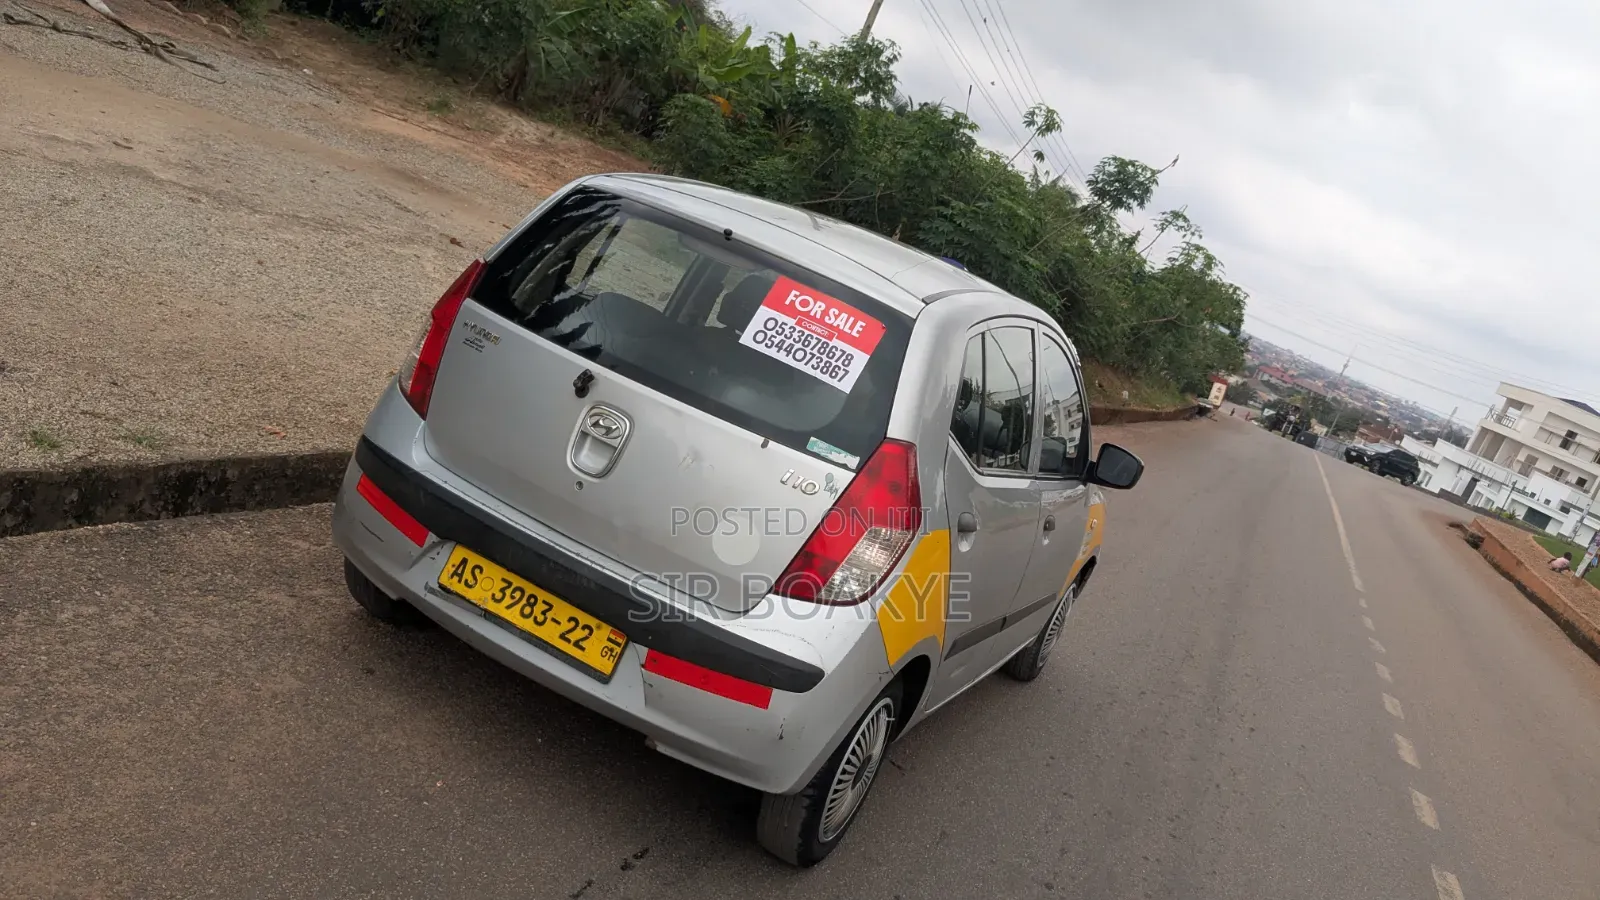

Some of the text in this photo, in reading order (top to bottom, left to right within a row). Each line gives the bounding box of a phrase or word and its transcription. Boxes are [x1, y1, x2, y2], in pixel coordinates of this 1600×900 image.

[785, 289, 866, 338] FOR SALE
[752, 330, 849, 383] 0544073867
[763, 317, 854, 368] 0533678678
[450, 557, 594, 652] AS 3983-22
[600, 645, 619, 663] GH
